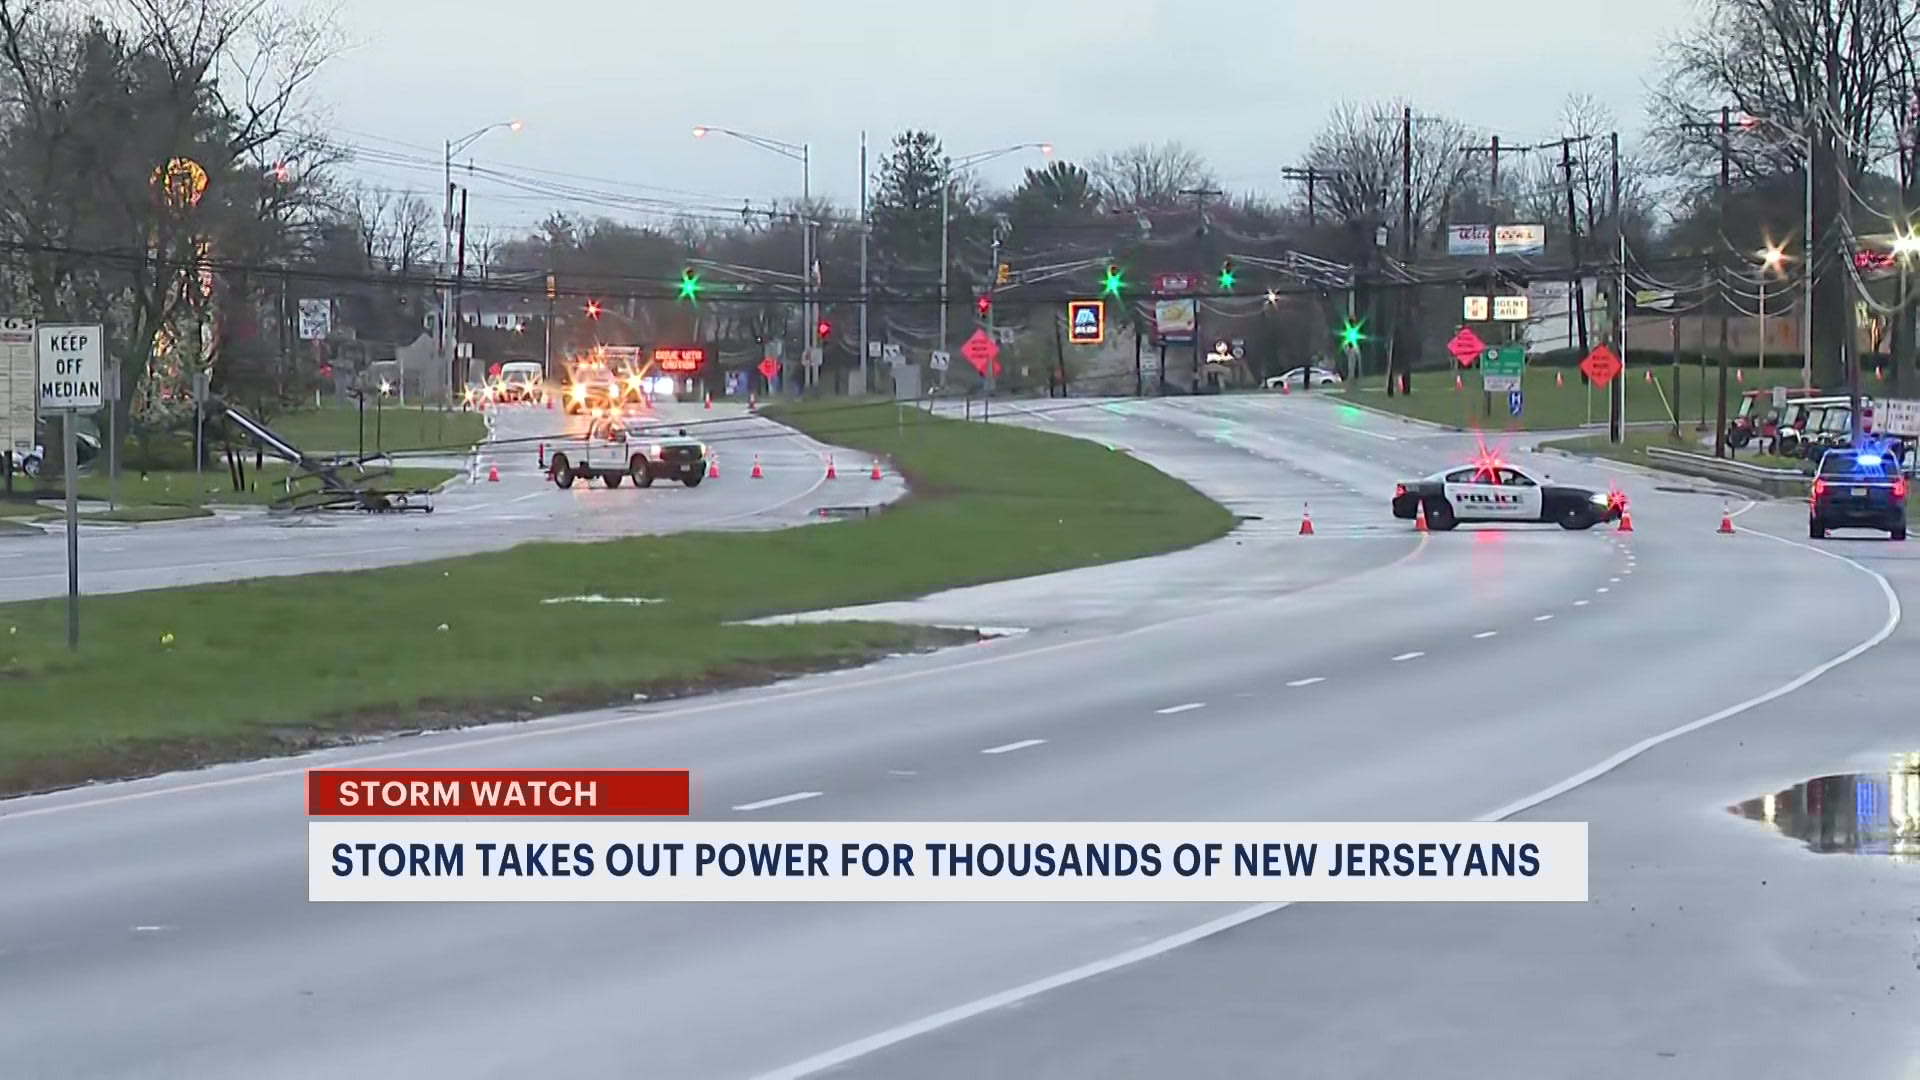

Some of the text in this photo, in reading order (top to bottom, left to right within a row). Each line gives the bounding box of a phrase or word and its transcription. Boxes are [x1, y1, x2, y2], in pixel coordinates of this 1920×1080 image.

[1457, 227, 1533, 242] Walgeens
[0, 317, 33, 330] 65
[50, 335, 88, 352] KEEP
[56, 358, 84, 375] OFF
[42, 381, 99, 398] MEDIAN
[1456, 493, 1524, 503] POLICE
